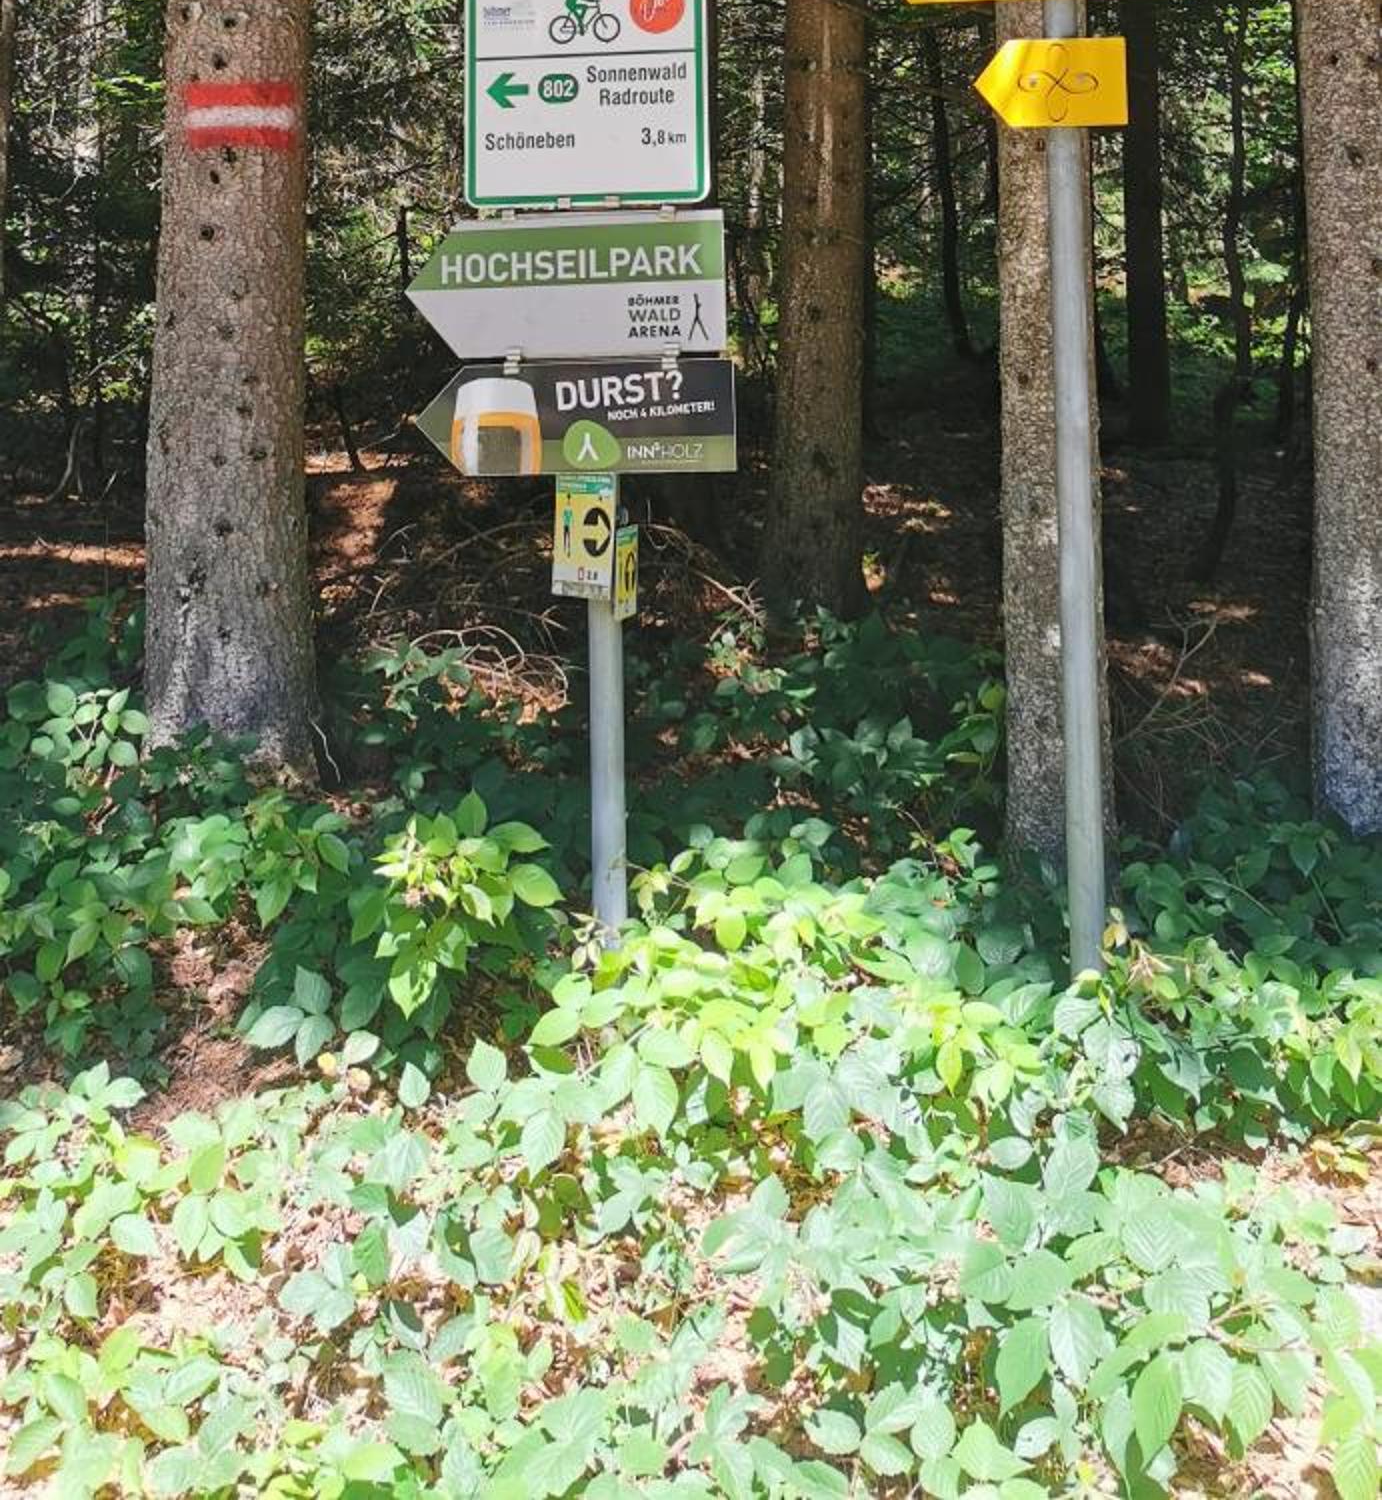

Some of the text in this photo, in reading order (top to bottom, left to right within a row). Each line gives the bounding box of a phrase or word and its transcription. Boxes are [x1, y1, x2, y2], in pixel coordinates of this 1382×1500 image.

[586, 62, 687, 83] Sonnenwald
[542, 79, 575, 98] 802
[599, 87, 675, 106] Radroute
[485, 132, 576, 151] Schöneben
[641, 127, 687, 147] 3,8 km
[440, 243, 703, 285] HOCHSEILPARK
[627, 293, 680, 307] BÖHMER
[627, 307, 681, 323] WALD
[627, 324, 682, 338] ARENA
[555, 369, 684, 412] DURST?
[607, 400, 717, 421] NOCH 4 KILOMETER!
